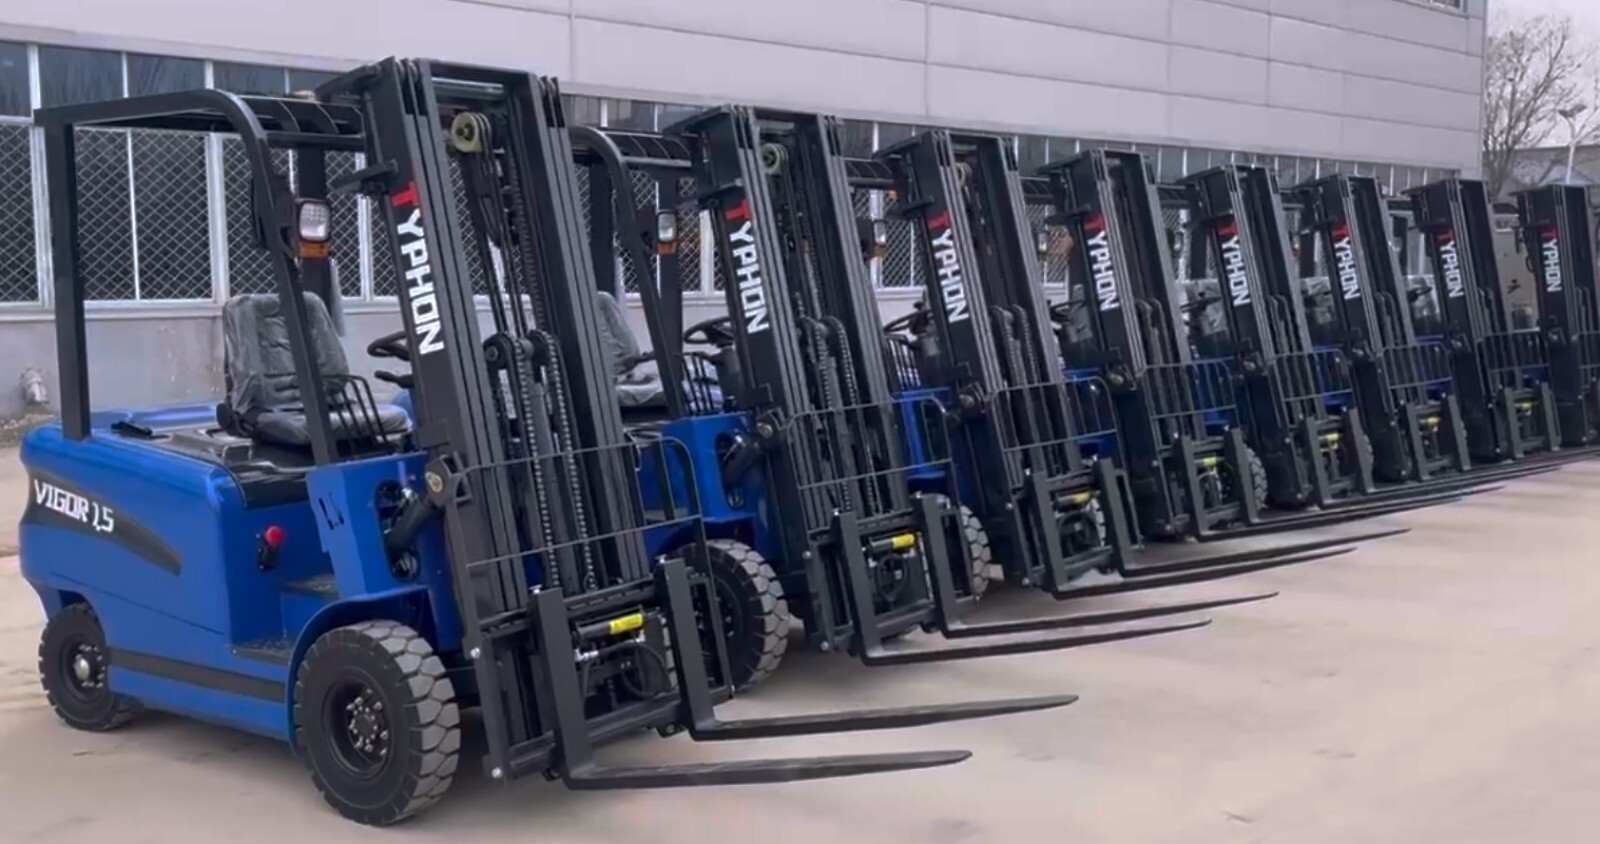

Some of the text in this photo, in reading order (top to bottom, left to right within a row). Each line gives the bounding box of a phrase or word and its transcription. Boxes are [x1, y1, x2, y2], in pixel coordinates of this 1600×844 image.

[391, 181, 445, 355] TYPHON
[725, 199, 770, 333] TYPHON
[928, 211, 970, 323] TYPHON
[1084, 214, 1120, 311] TYPHON
[1218, 221, 1251, 306] TYPHON
[1332, 223, 1361, 300] TYPHON
[1438, 230, 1464, 298] TYPHON
[1541, 228, 1563, 292] TYPHON
[34, 479, 89, 524] VIGOR
